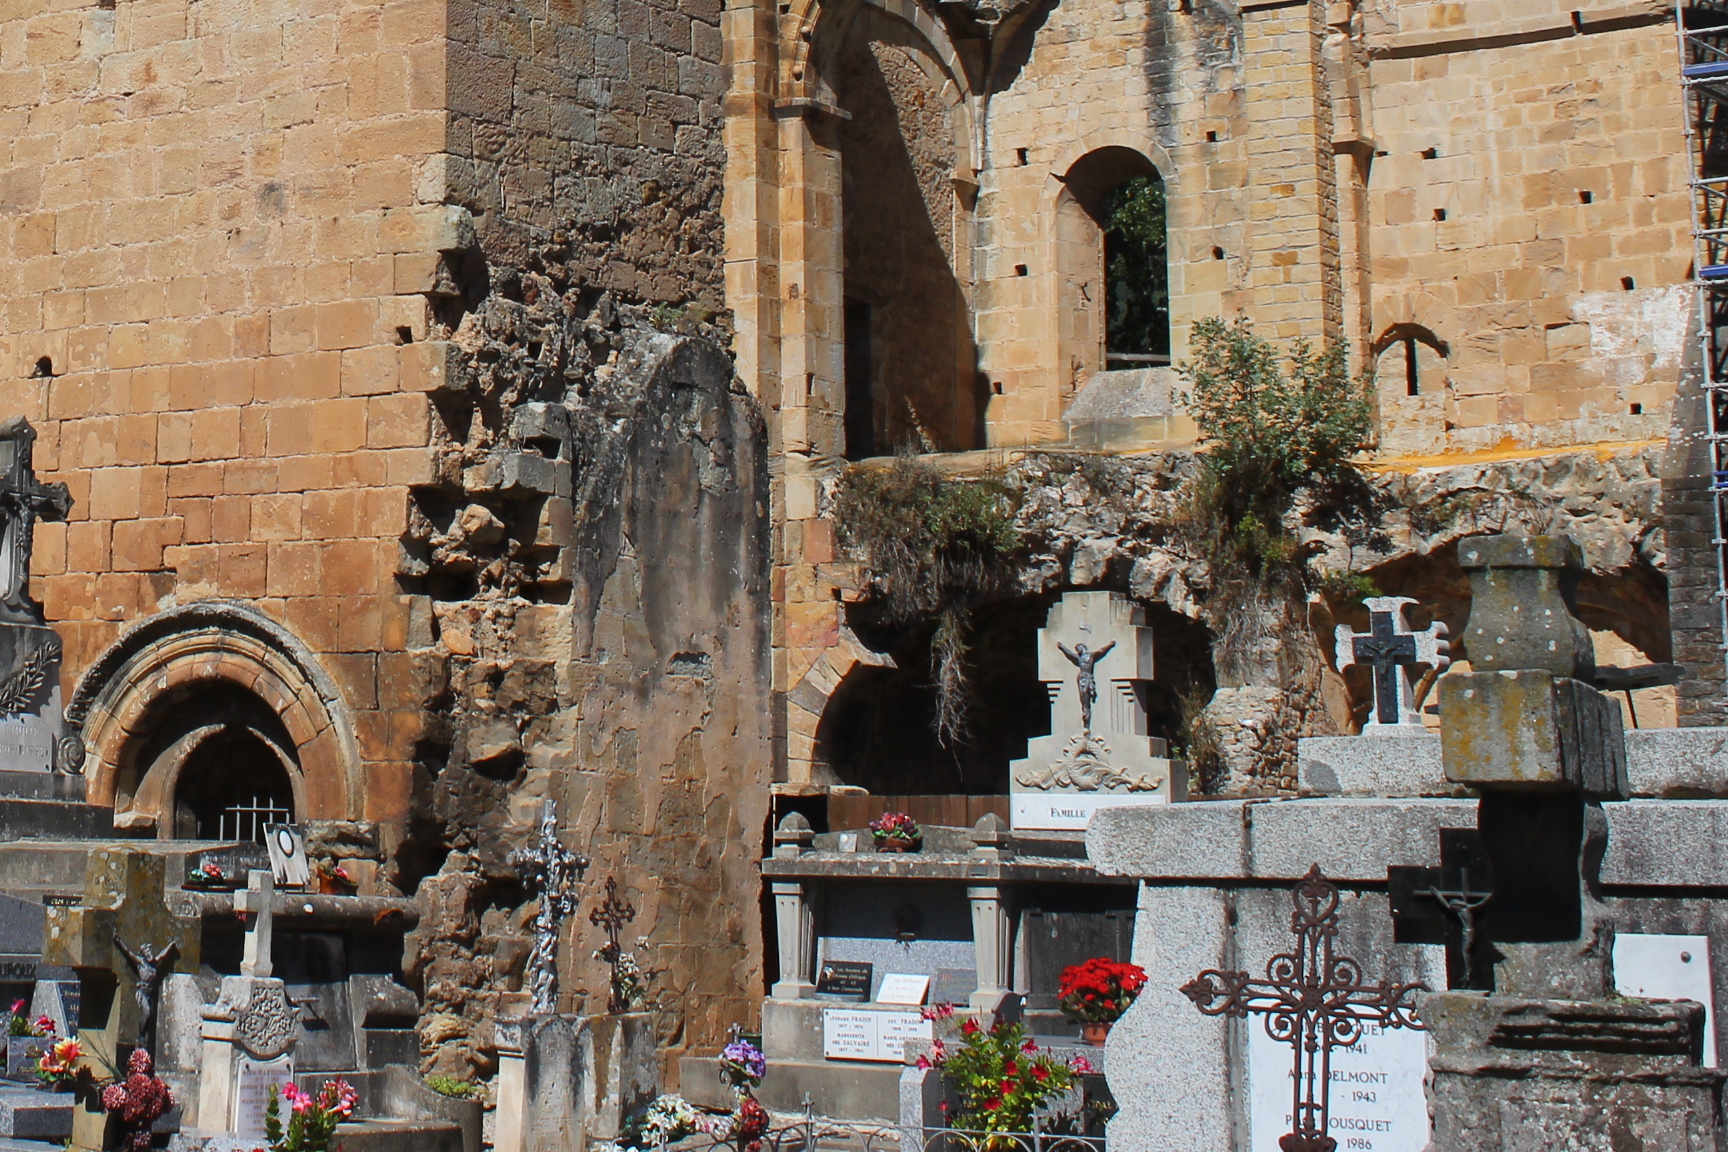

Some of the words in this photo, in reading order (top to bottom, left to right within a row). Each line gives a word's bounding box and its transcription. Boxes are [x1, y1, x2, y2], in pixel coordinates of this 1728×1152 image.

[1050, 807, 1086, 818] FAMILLE
[843, 1039, 870, 1047] SALVAIRE
[1352, 1091, 1377, 1103] 1943
[1346, 1137, 1373, 1150] 1986
